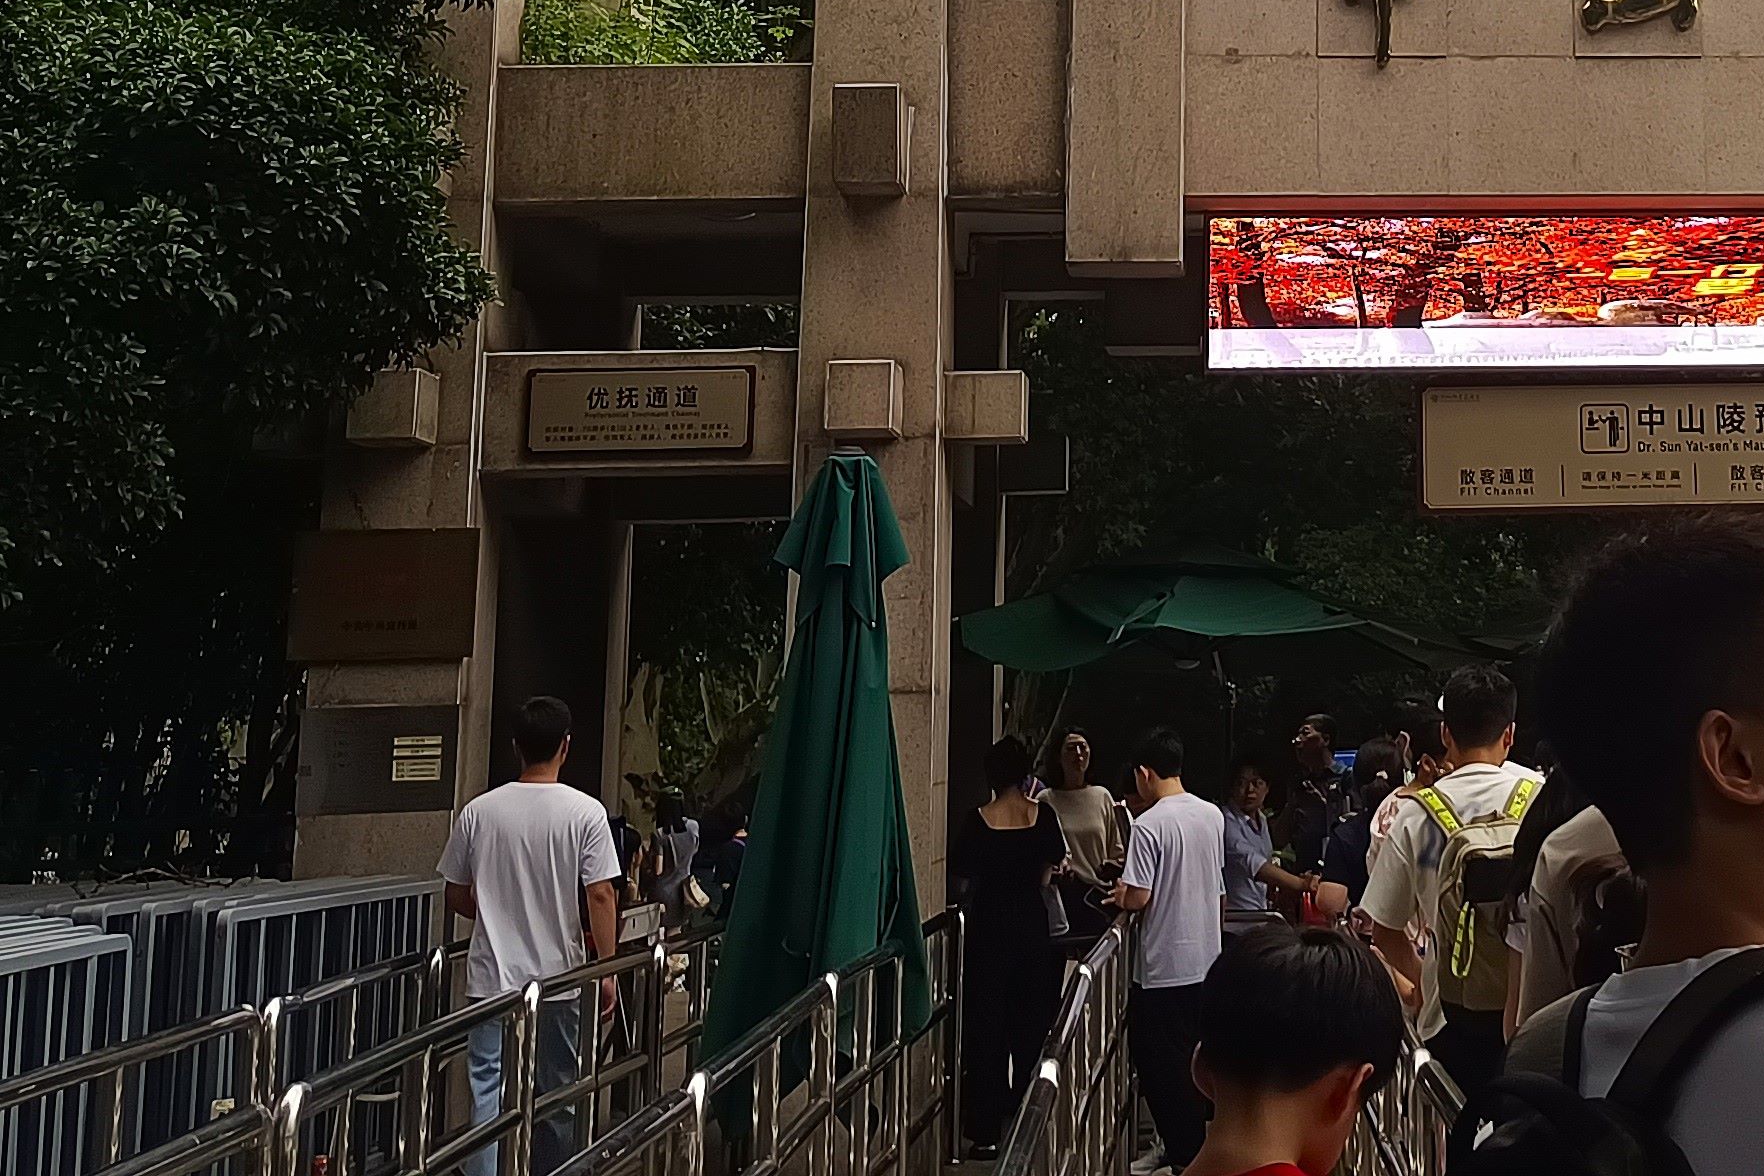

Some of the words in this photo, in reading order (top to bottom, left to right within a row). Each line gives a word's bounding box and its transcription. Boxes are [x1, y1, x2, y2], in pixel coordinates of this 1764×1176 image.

[586, 385, 700, 411] 优抚通道
[1637, 440, 1656, 453] Dr.
[1660, 440, 1682, 452] Sun
[1686, 438, 1740, 452] Yat-sen's
[1460, 468, 1535, 485] 散客通道
[1460, 486, 1479, 496] FIT
[1484, 486, 1535, 496] Channel
[1730, 482, 1748, 492] FIT
